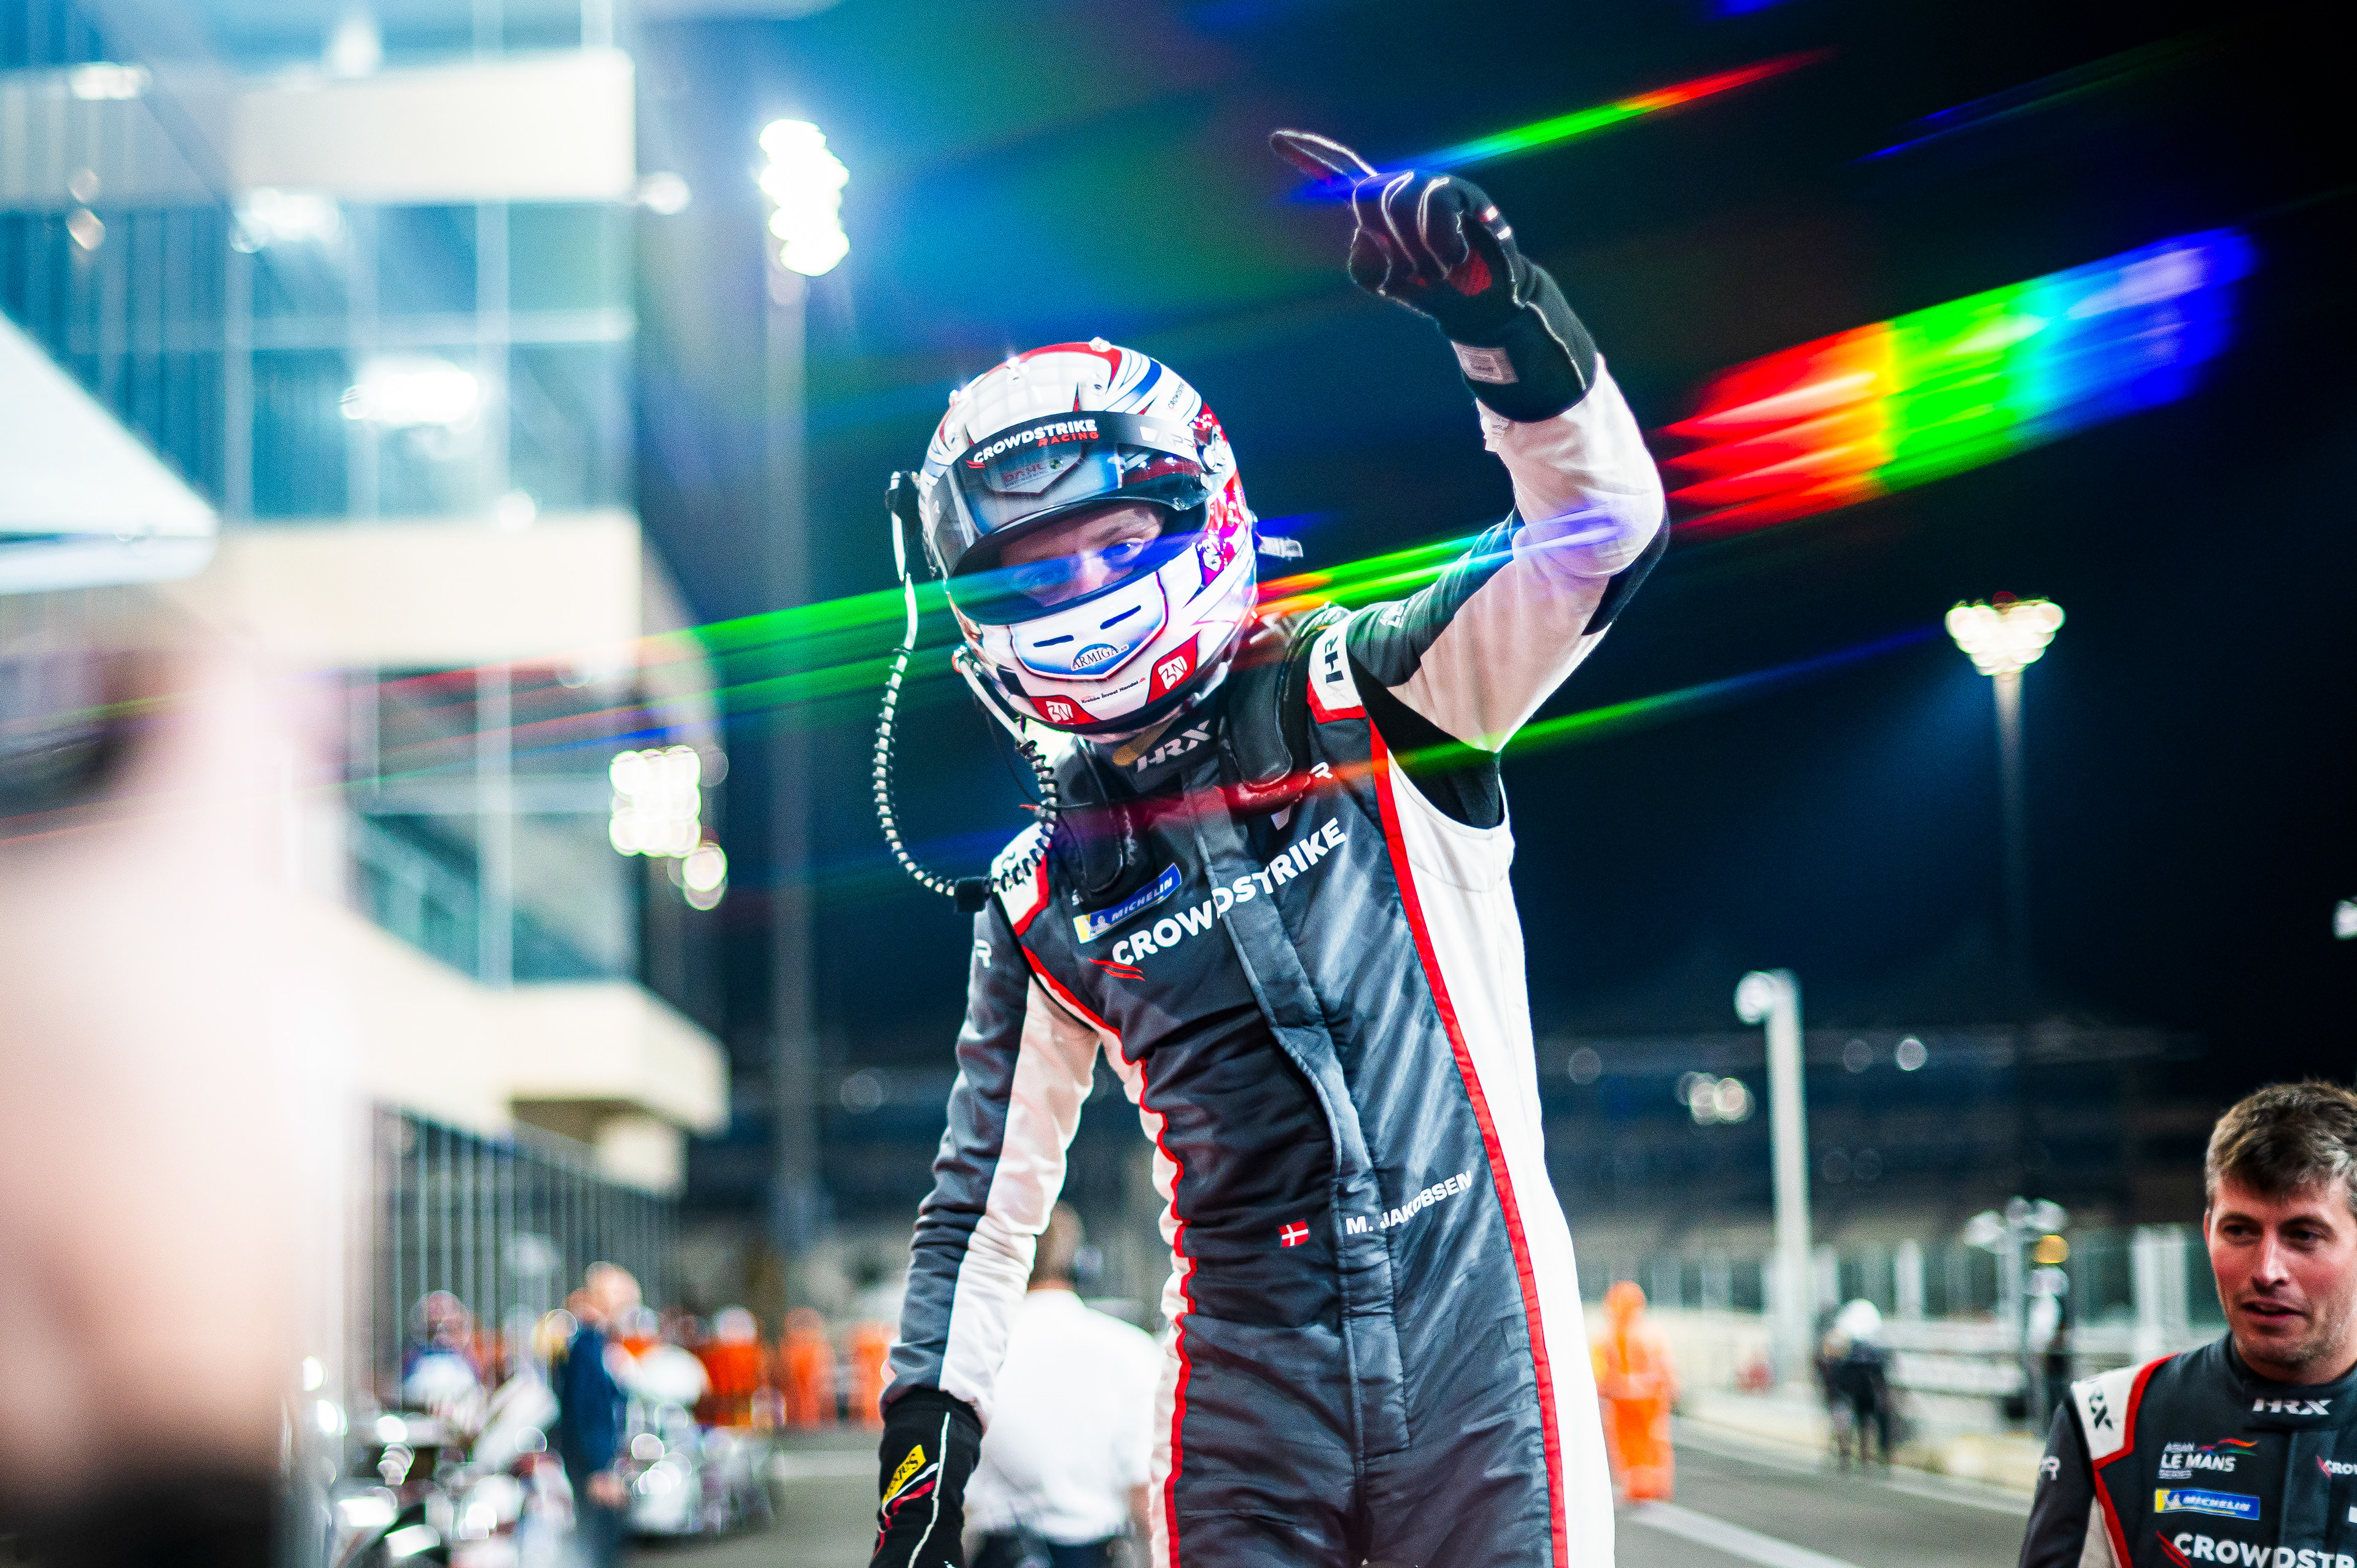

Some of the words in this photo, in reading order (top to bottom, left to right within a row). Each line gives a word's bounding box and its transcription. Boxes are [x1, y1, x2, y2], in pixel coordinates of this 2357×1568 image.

[973, 419, 1097, 463] CROWDSTRIKE
[1038, 431, 1099, 447] RACING
[1073, 646, 1120, 670] ARMIGA
[1101, 689, 1119, 698] Invest
[1134, 719, 1213, 773] HRX
[1112, 817, 1347, 965] CROWDSTRIKE
[1112, 876, 1172, 922] MICHELIN
[1345, 1216, 1373, 1235] M.
[1379, 1170, 1473, 1229] JAKOBSEN
[2252, 1397, 2334, 1416] HRX
[2160, 1453, 2183, 1469] LE
[2185, 1453, 2237, 1472] MANS
[2183, 1495, 2251, 1512] MICHELIN
